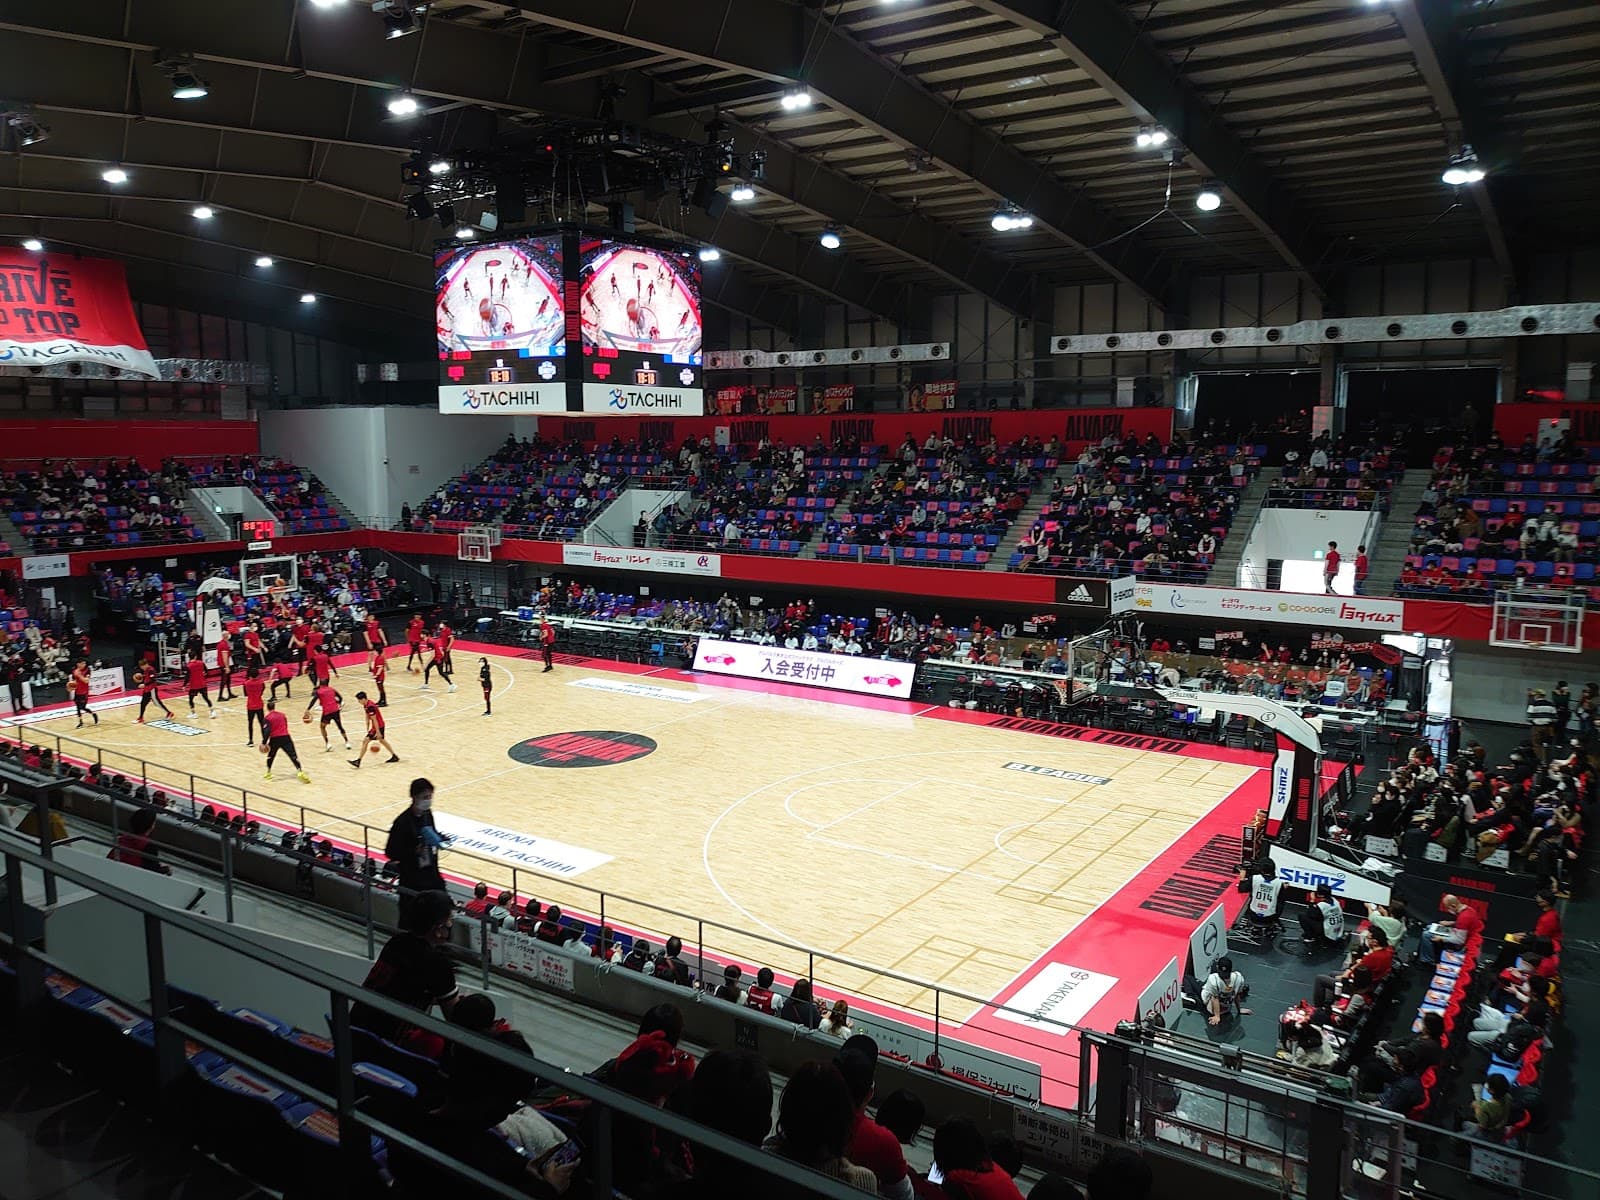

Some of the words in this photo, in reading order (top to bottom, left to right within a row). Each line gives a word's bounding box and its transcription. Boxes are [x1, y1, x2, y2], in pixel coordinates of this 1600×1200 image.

[14, 308, 80, 335] TOP
[9, 343, 127, 361] TACHIHI
[480, 391, 540, 406] TACHIHI
[627, 392, 682, 408] TACHIHI
[255, 520, 275, 540] 24
[626, 555, 651, 564] リンレイ
[1067, 594, 1093, 602] adidas
[1339, 602, 1401, 623] トヨタイムズ
[760, 657, 836, 682] 入会受付中
[986, 716, 1089, 739] ALVARK
[1091, 731, 1189, 753] TOKYO
[1006, 762, 1107, 785] B.LEAGUE
[477, 828, 537, 846] ARENA
[502, 849, 576, 873] TACHIHI
[1255, 891, 1273, 903] 014
[1146, 979, 1178, 1017] ENSO
[1027, 1131, 1058, 1148] エリア
